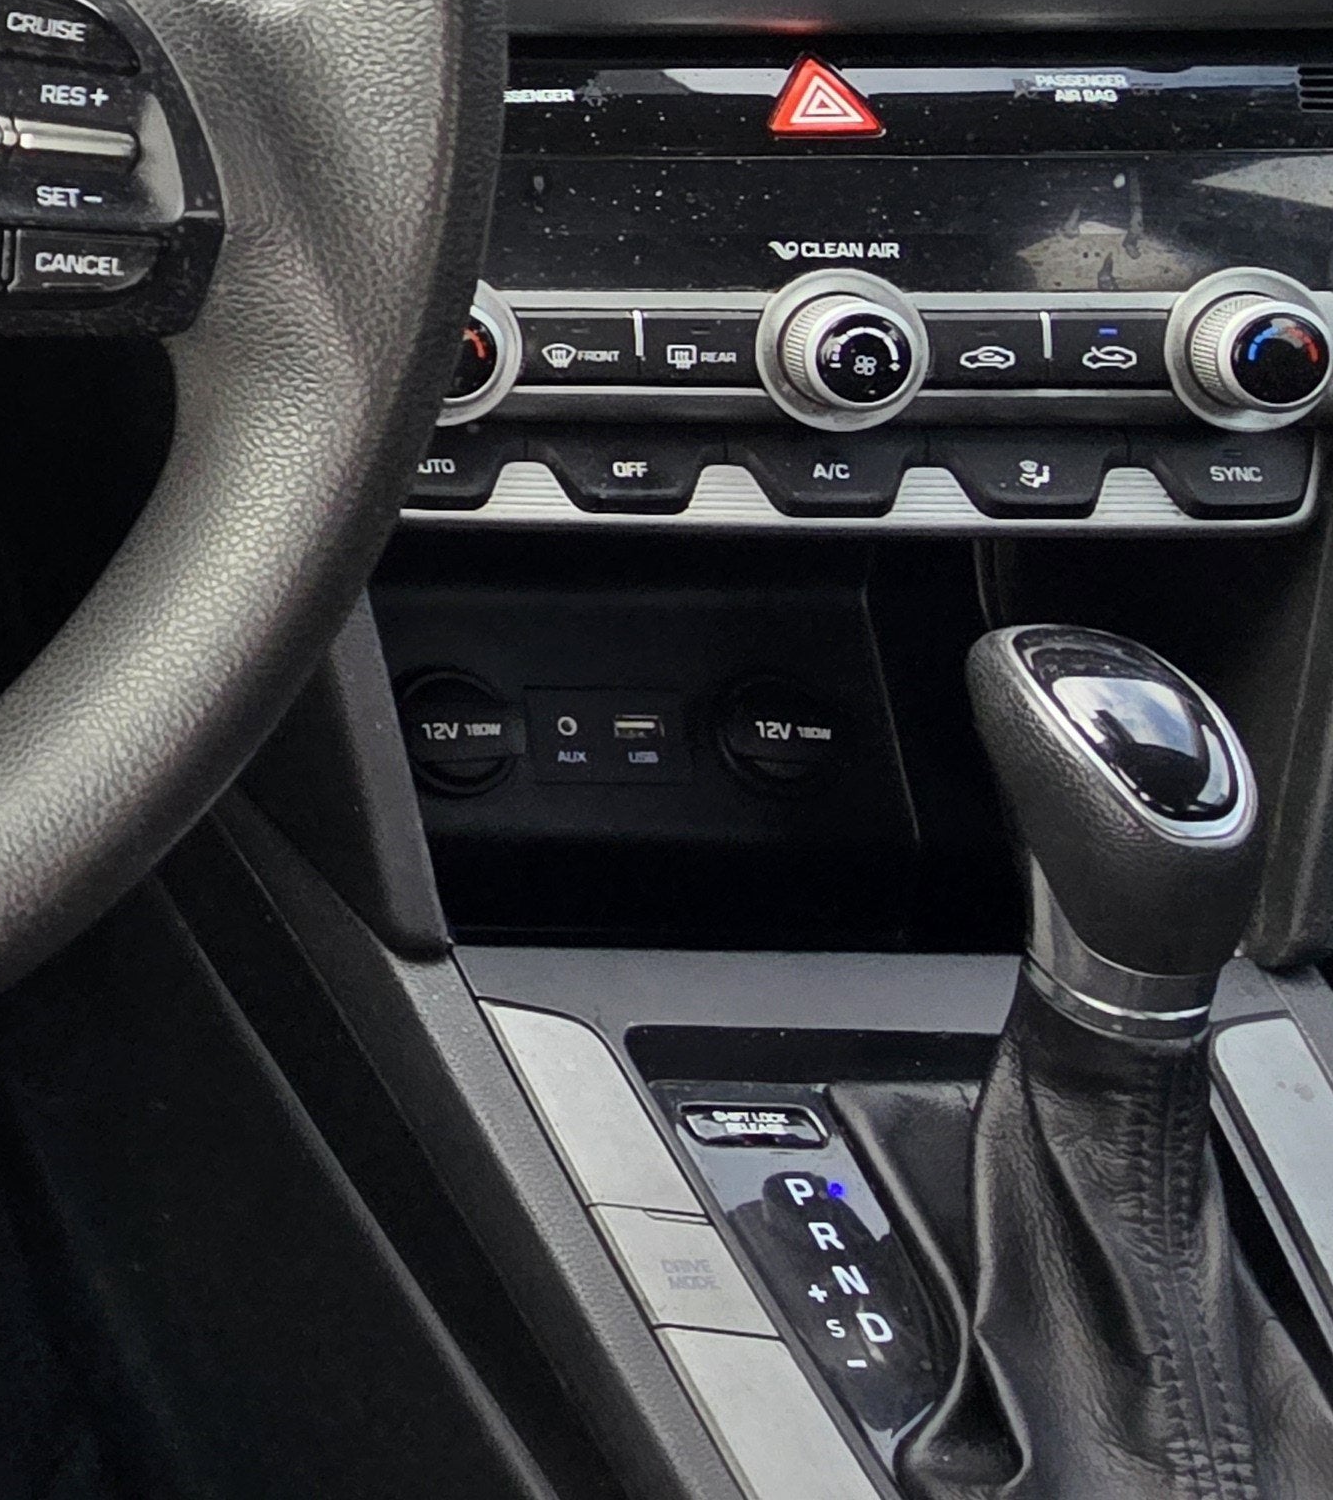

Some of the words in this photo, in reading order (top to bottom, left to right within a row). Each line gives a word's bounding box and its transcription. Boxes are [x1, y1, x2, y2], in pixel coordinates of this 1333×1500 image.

[6, 11, 88, 42] CRUISE
[1034, 74, 1129, 88] PASSENGER
[503, 89, 575, 102] SSENGER
[1055, 89, 1082, 102] AIR
[801, 242, 864, 258] CLEAN
[867, 242, 900, 258] AIR
[35, 253, 125, 276] CANCEL
[577, 349, 620, 362] FRONT
[700, 352, 737, 364] REAR
[612, 462, 648, 478] OFF
[812, 462, 851, 479] A/C
[1209, 466, 1263, 482] SYNC
[422, 722, 460, 740] 12V
[755, 720, 792, 740] 12V
[557, 751, 587, 764] AUX
[628, 751, 659, 764] USB
[784, 1178, 814, 1206] P
[808, 1222, 845, 1250] R
[661, 1259, 713, 1274] DRIVE
[668, 1275, 721, 1290] MODE
[832, 1265, 870, 1295] N
[826, 1319, 846, 1338] S
[856, 1312, 893, 1343] D
